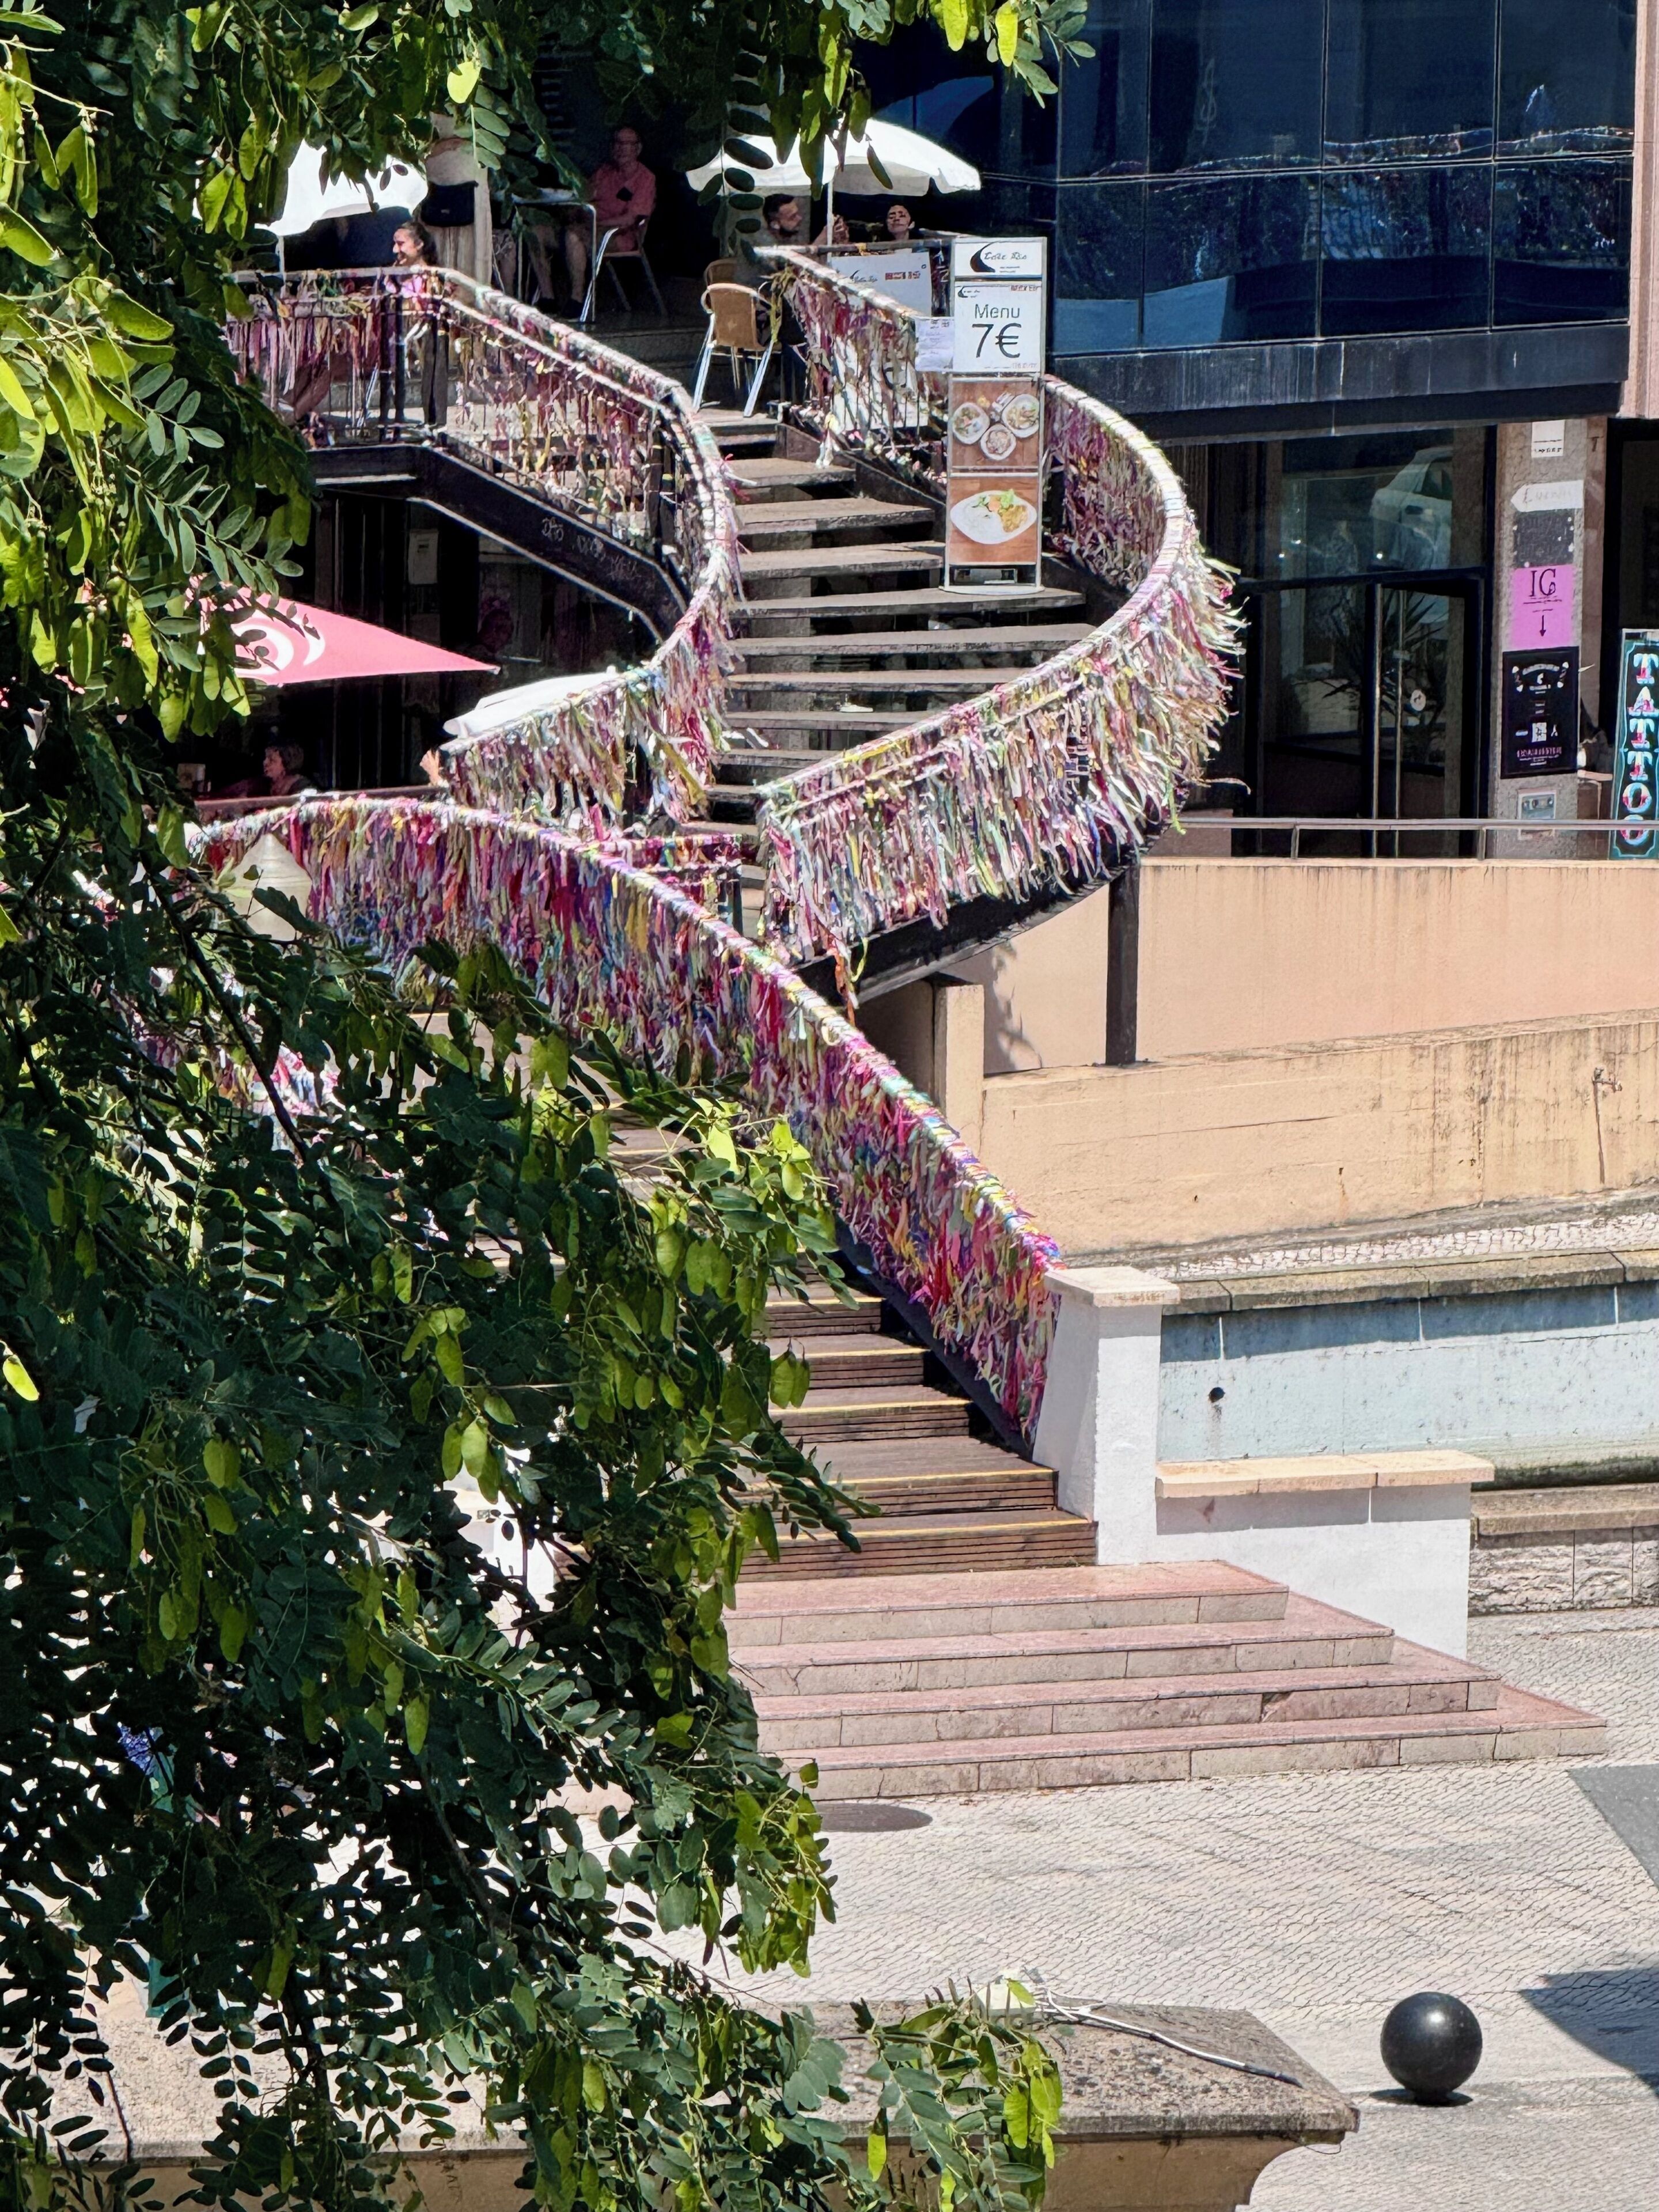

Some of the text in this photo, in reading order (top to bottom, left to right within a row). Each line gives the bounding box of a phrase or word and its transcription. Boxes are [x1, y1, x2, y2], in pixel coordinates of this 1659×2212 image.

[975, 304, 1020, 319] Menu
[972, 323, 1022, 358] 7€
[1619, 653, 1659, 846] TATTOO
